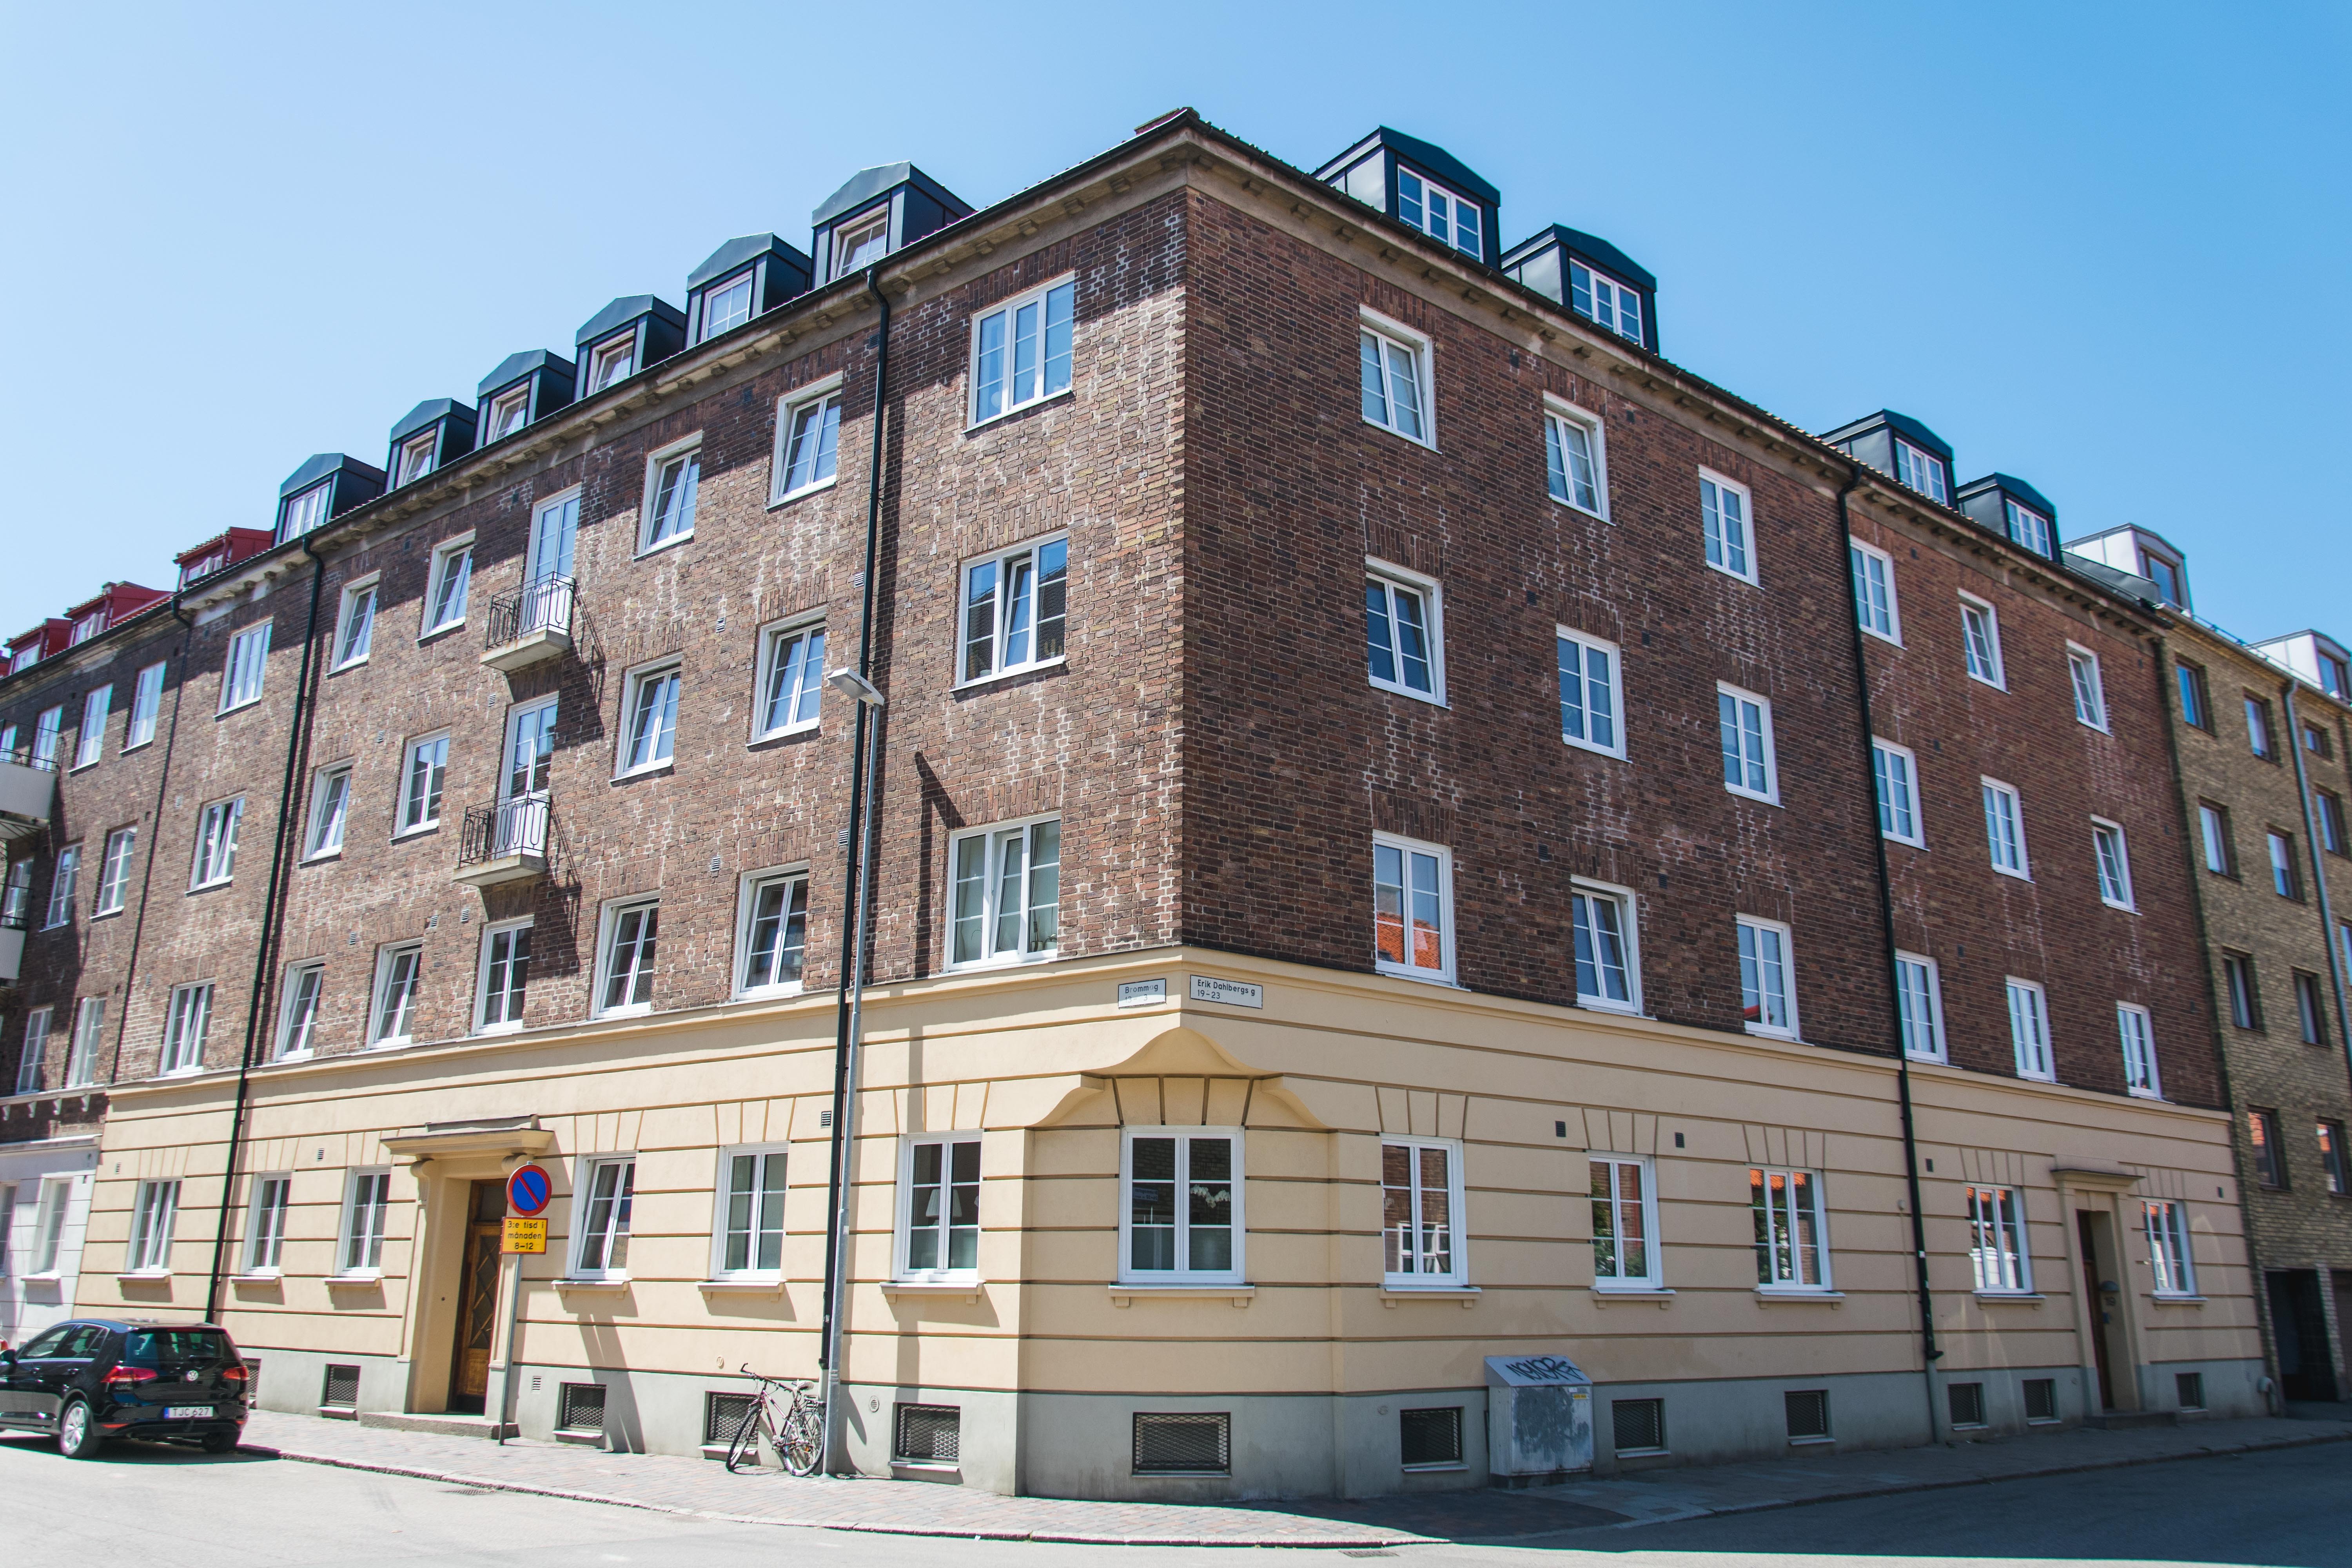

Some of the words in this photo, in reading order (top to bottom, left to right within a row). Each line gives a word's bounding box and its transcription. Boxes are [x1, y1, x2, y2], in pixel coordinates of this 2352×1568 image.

[1125, 984, 1158, 994] Brommag
[1198, 979, 1210, 988] Erik
[1213, 982, 1249, 995] Dahlbergs
[1125, 994, 1147, 1003] 13-3
[1198, 989, 1220, 999] 19-23
[173, 1408, 190, 1416] TJC
[192, 1407, 209, 1416] 627
